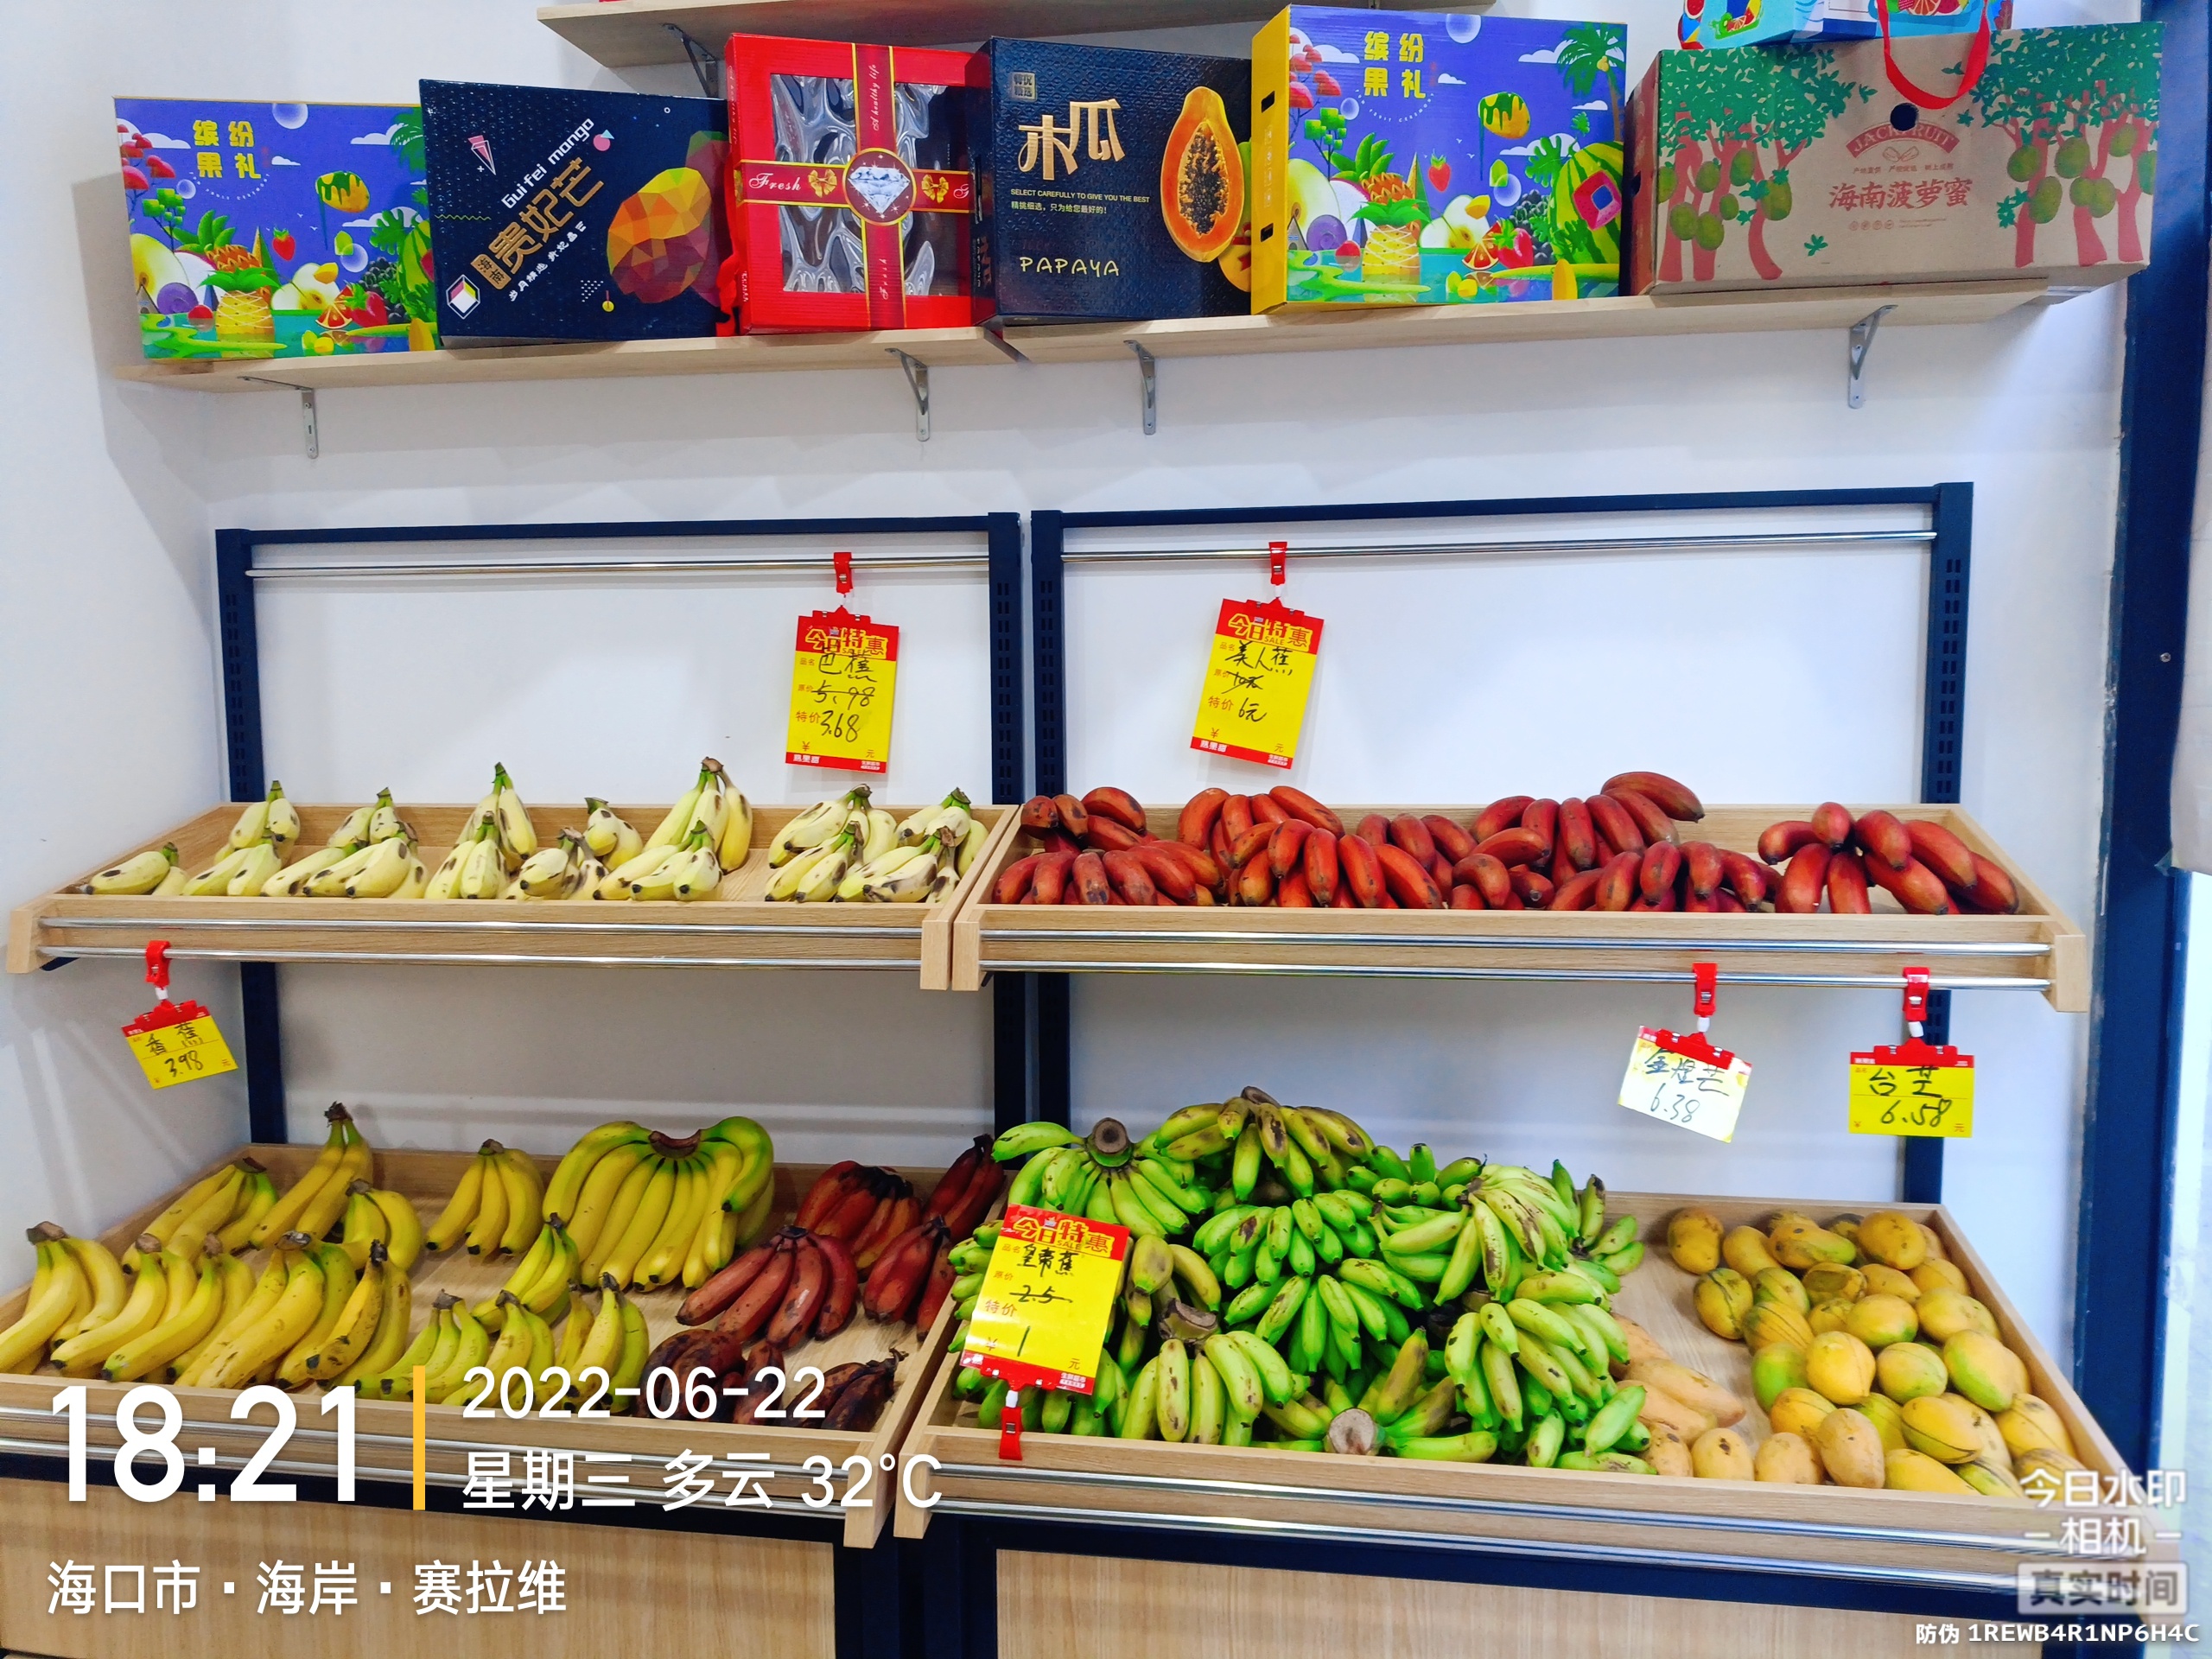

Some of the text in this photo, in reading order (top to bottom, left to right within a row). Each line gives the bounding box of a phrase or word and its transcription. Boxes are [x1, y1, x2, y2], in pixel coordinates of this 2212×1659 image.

[1364, 30, 1424, 63] 缤纷
[1363, 67, 1427, 99] 果礼
[193, 120, 255, 148] 缤纷
[547, 118, 594, 165] mango
[1018, 98, 1125, 181] 木瓜
[196, 152, 262, 179] 果礼
[748, 173, 801, 191] Fresh
[1010, 188, 1037, 197] SELECT
[1037, 190, 1076, 200] CAREFULLY
[1828, 176, 1974, 212] 海南菠萝蜜
[488, 156, 605, 275] 贵妃芒
[1019, 256, 1120, 278] PAPAYA
[1228, 613, 1313, 652] 今日特惠
[1264, 635, 1285, 645] SALE
[1224, 639, 1294, 676] 美人蕉
[1208, 696, 1234, 711] 特价
[796, 710, 861, 743] 特价 3.68
[866, 749, 874, 758] 元
[1274, 743, 1284, 753] 元
[164, 1050, 204, 1077] 3.98
[1650, 1083, 1700, 1123] 6.38
[1880, 1098, 1953, 1128] 6.58
[1013, 1217, 1116, 1258] 今日特惠
[1057, 1239, 1081, 1250] SALE
[994, 1270, 1014, 1281] 原价
[985, 1299, 1018, 1317] 特价
[1068, 1357, 1081, 1370] 元
